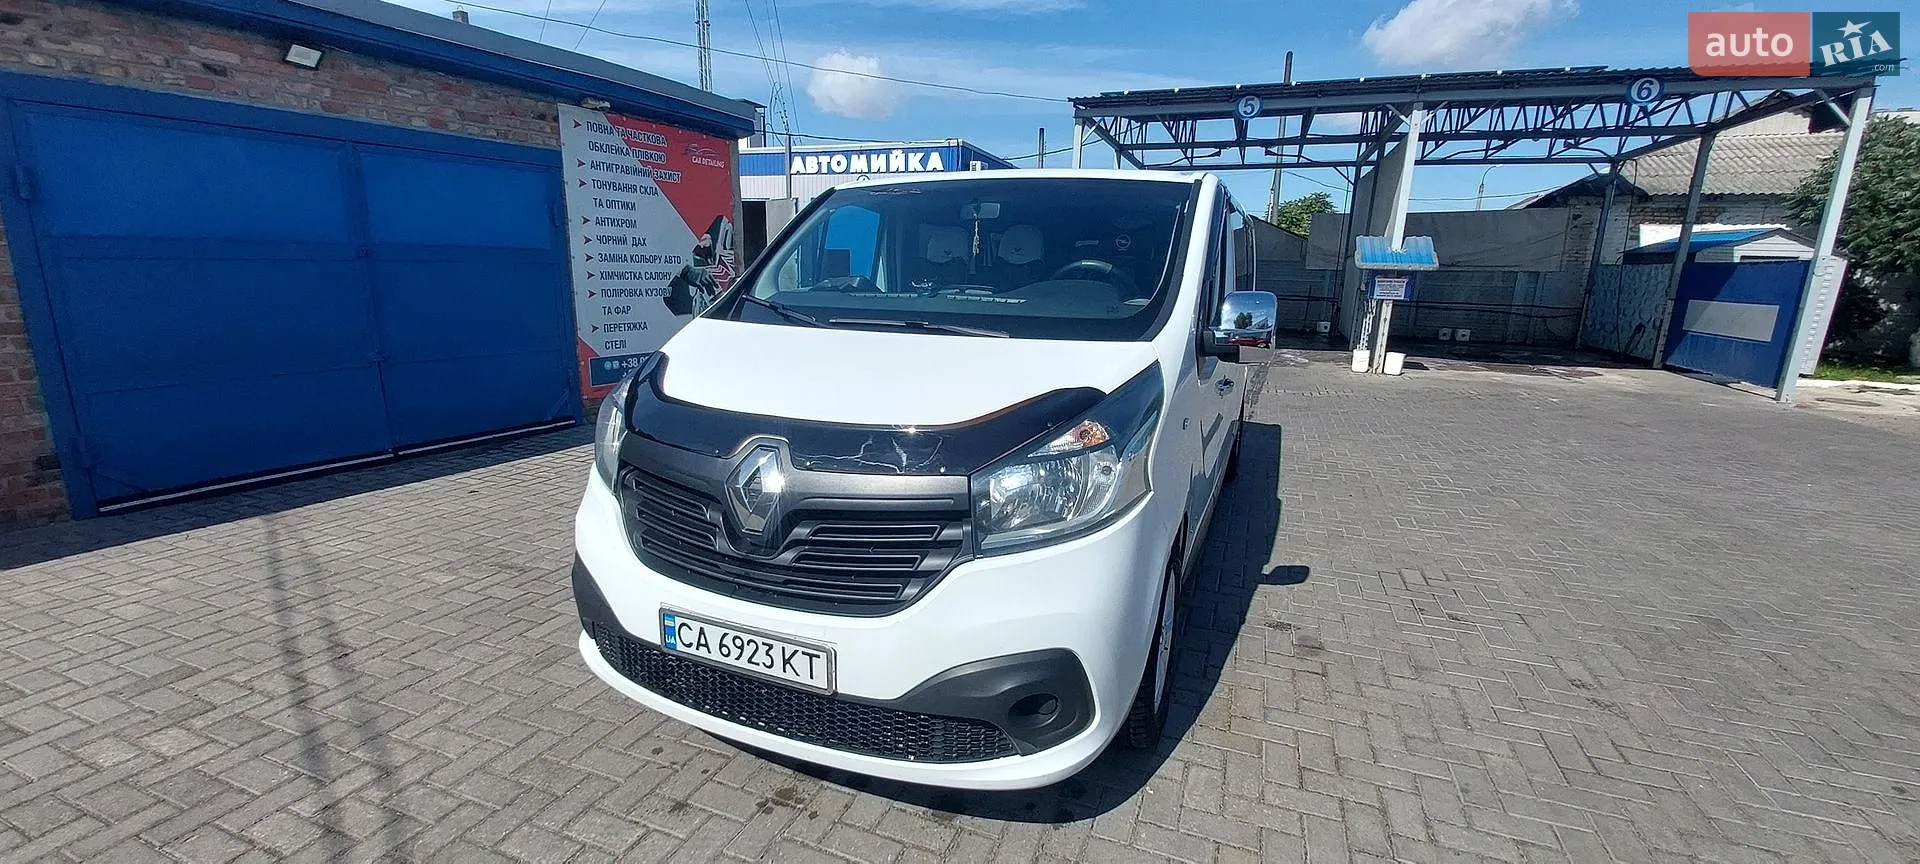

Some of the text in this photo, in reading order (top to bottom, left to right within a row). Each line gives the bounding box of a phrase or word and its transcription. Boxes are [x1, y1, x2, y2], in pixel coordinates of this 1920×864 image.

[1636, 80, 1654, 101] 6
[1243, 98, 1256, 115] 5
[586, 121, 667, 146] ПОВНА ТА ЧАСТКОВА
[588, 140, 667, 163] ОБКЛЕЙКА ПЛІВКОЮ
[790, 149, 945, 175] АВТОМИЙКА
[590, 160, 681, 183] АНТИГРАВІЙНИЙ ЗАХИСТ
[592, 178, 659, 197] ТОНУВАННЯ СКЛА
[593, 197, 636, 211] ТА ОПТИКИ
[595, 216, 637, 229] АНТИХРОМ
[596, 234, 647, 247] ЧОРНИЙ ДАХ
[598, 252, 681, 265] ЗАМІНА КОЛЬОРУ АВТО
[600, 270, 672, 281] ХІМЧИСТКА САЛОНУ
[601, 286, 672, 299] ПОЛІРОВКА КУЗОВУ
[602, 305, 632, 316] ТА ФАР
[604, 322, 648, 333] ПЕРЕТЯЖКА
[605, 339, 627, 350] СТЕЛІ
[621, 357, 638, 368] +38
[665, 634, 677, 645] UA
[677, 622, 821, 680] CA 6923 KT
